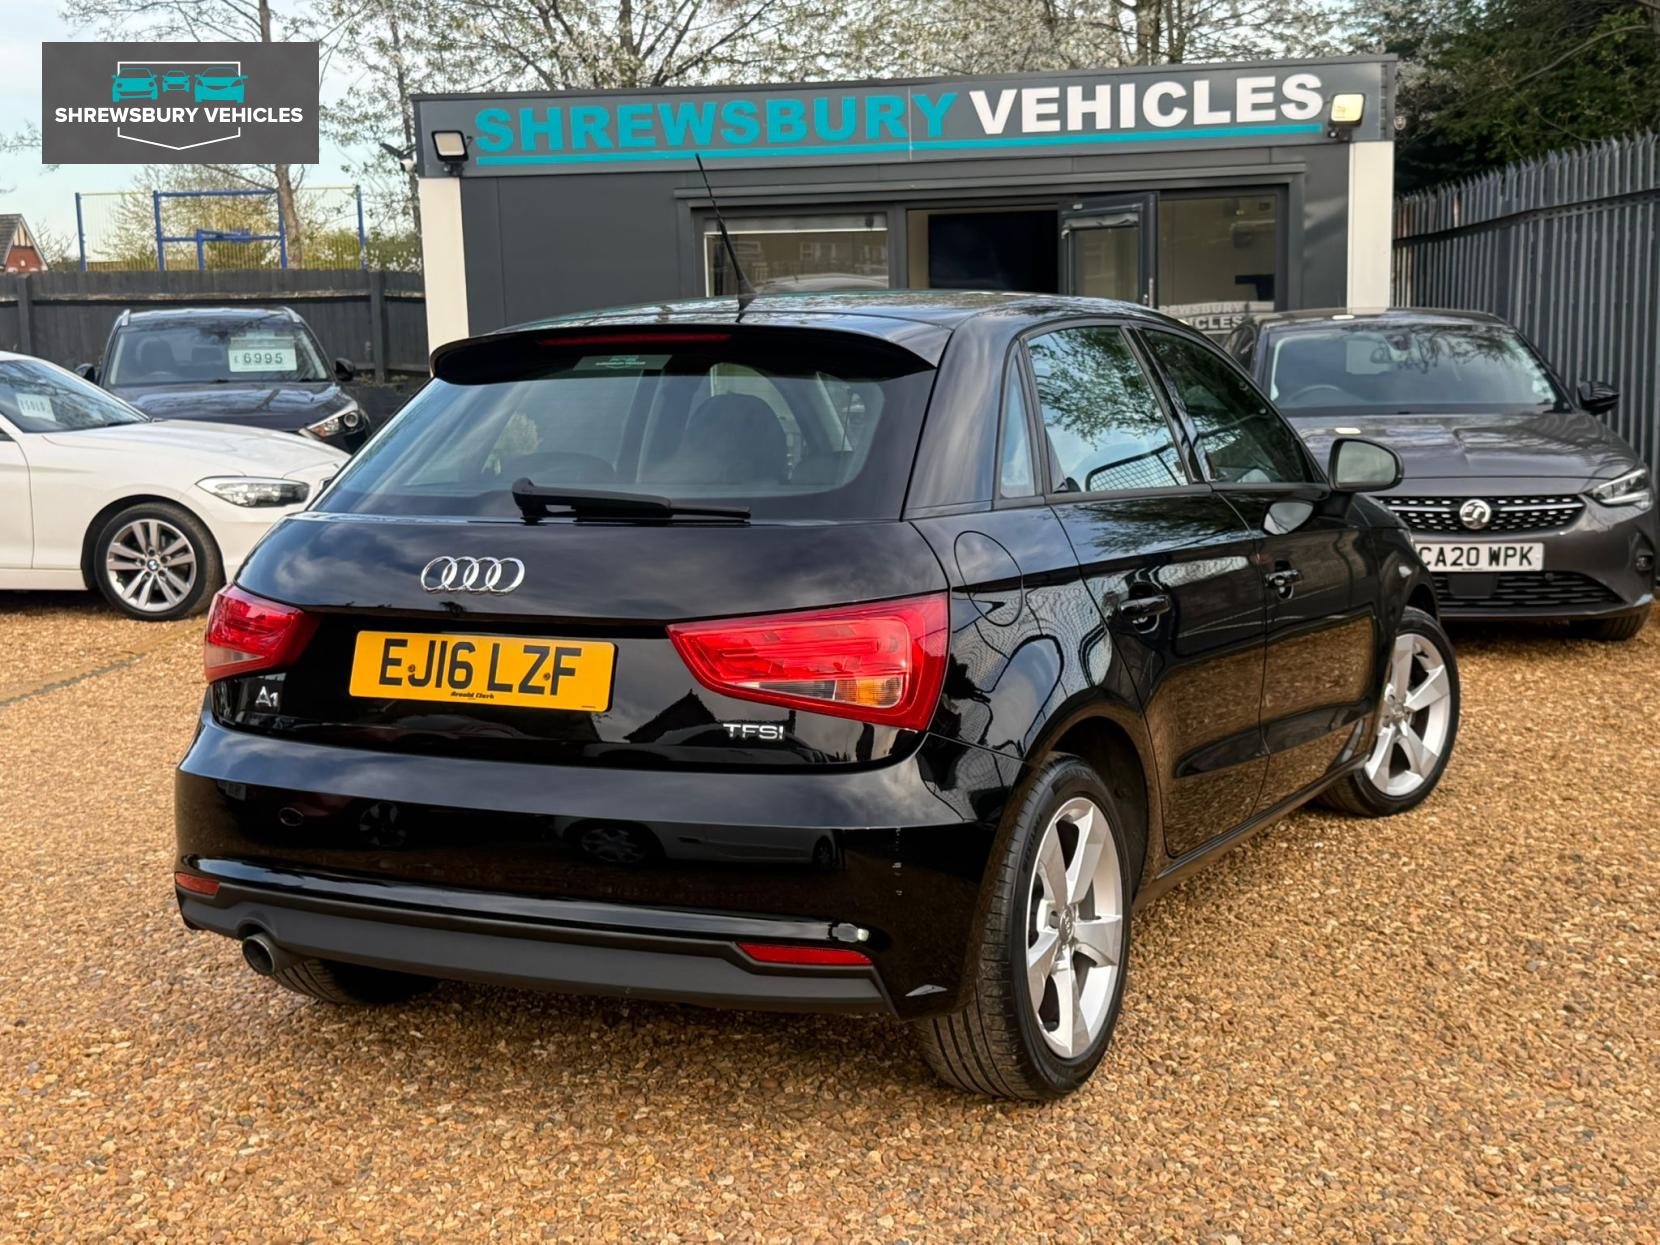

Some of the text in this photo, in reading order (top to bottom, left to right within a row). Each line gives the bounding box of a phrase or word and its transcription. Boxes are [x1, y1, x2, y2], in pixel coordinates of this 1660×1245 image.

[475, 73, 1323, 152] SHREWSBURY VEHICLES
[1419, 546, 1534, 567] CA20 WPK
[379, 638, 583, 696] EJ16 LZF
[255, 686, 279, 708] A1
[723, 723, 784, 740] TFSI
